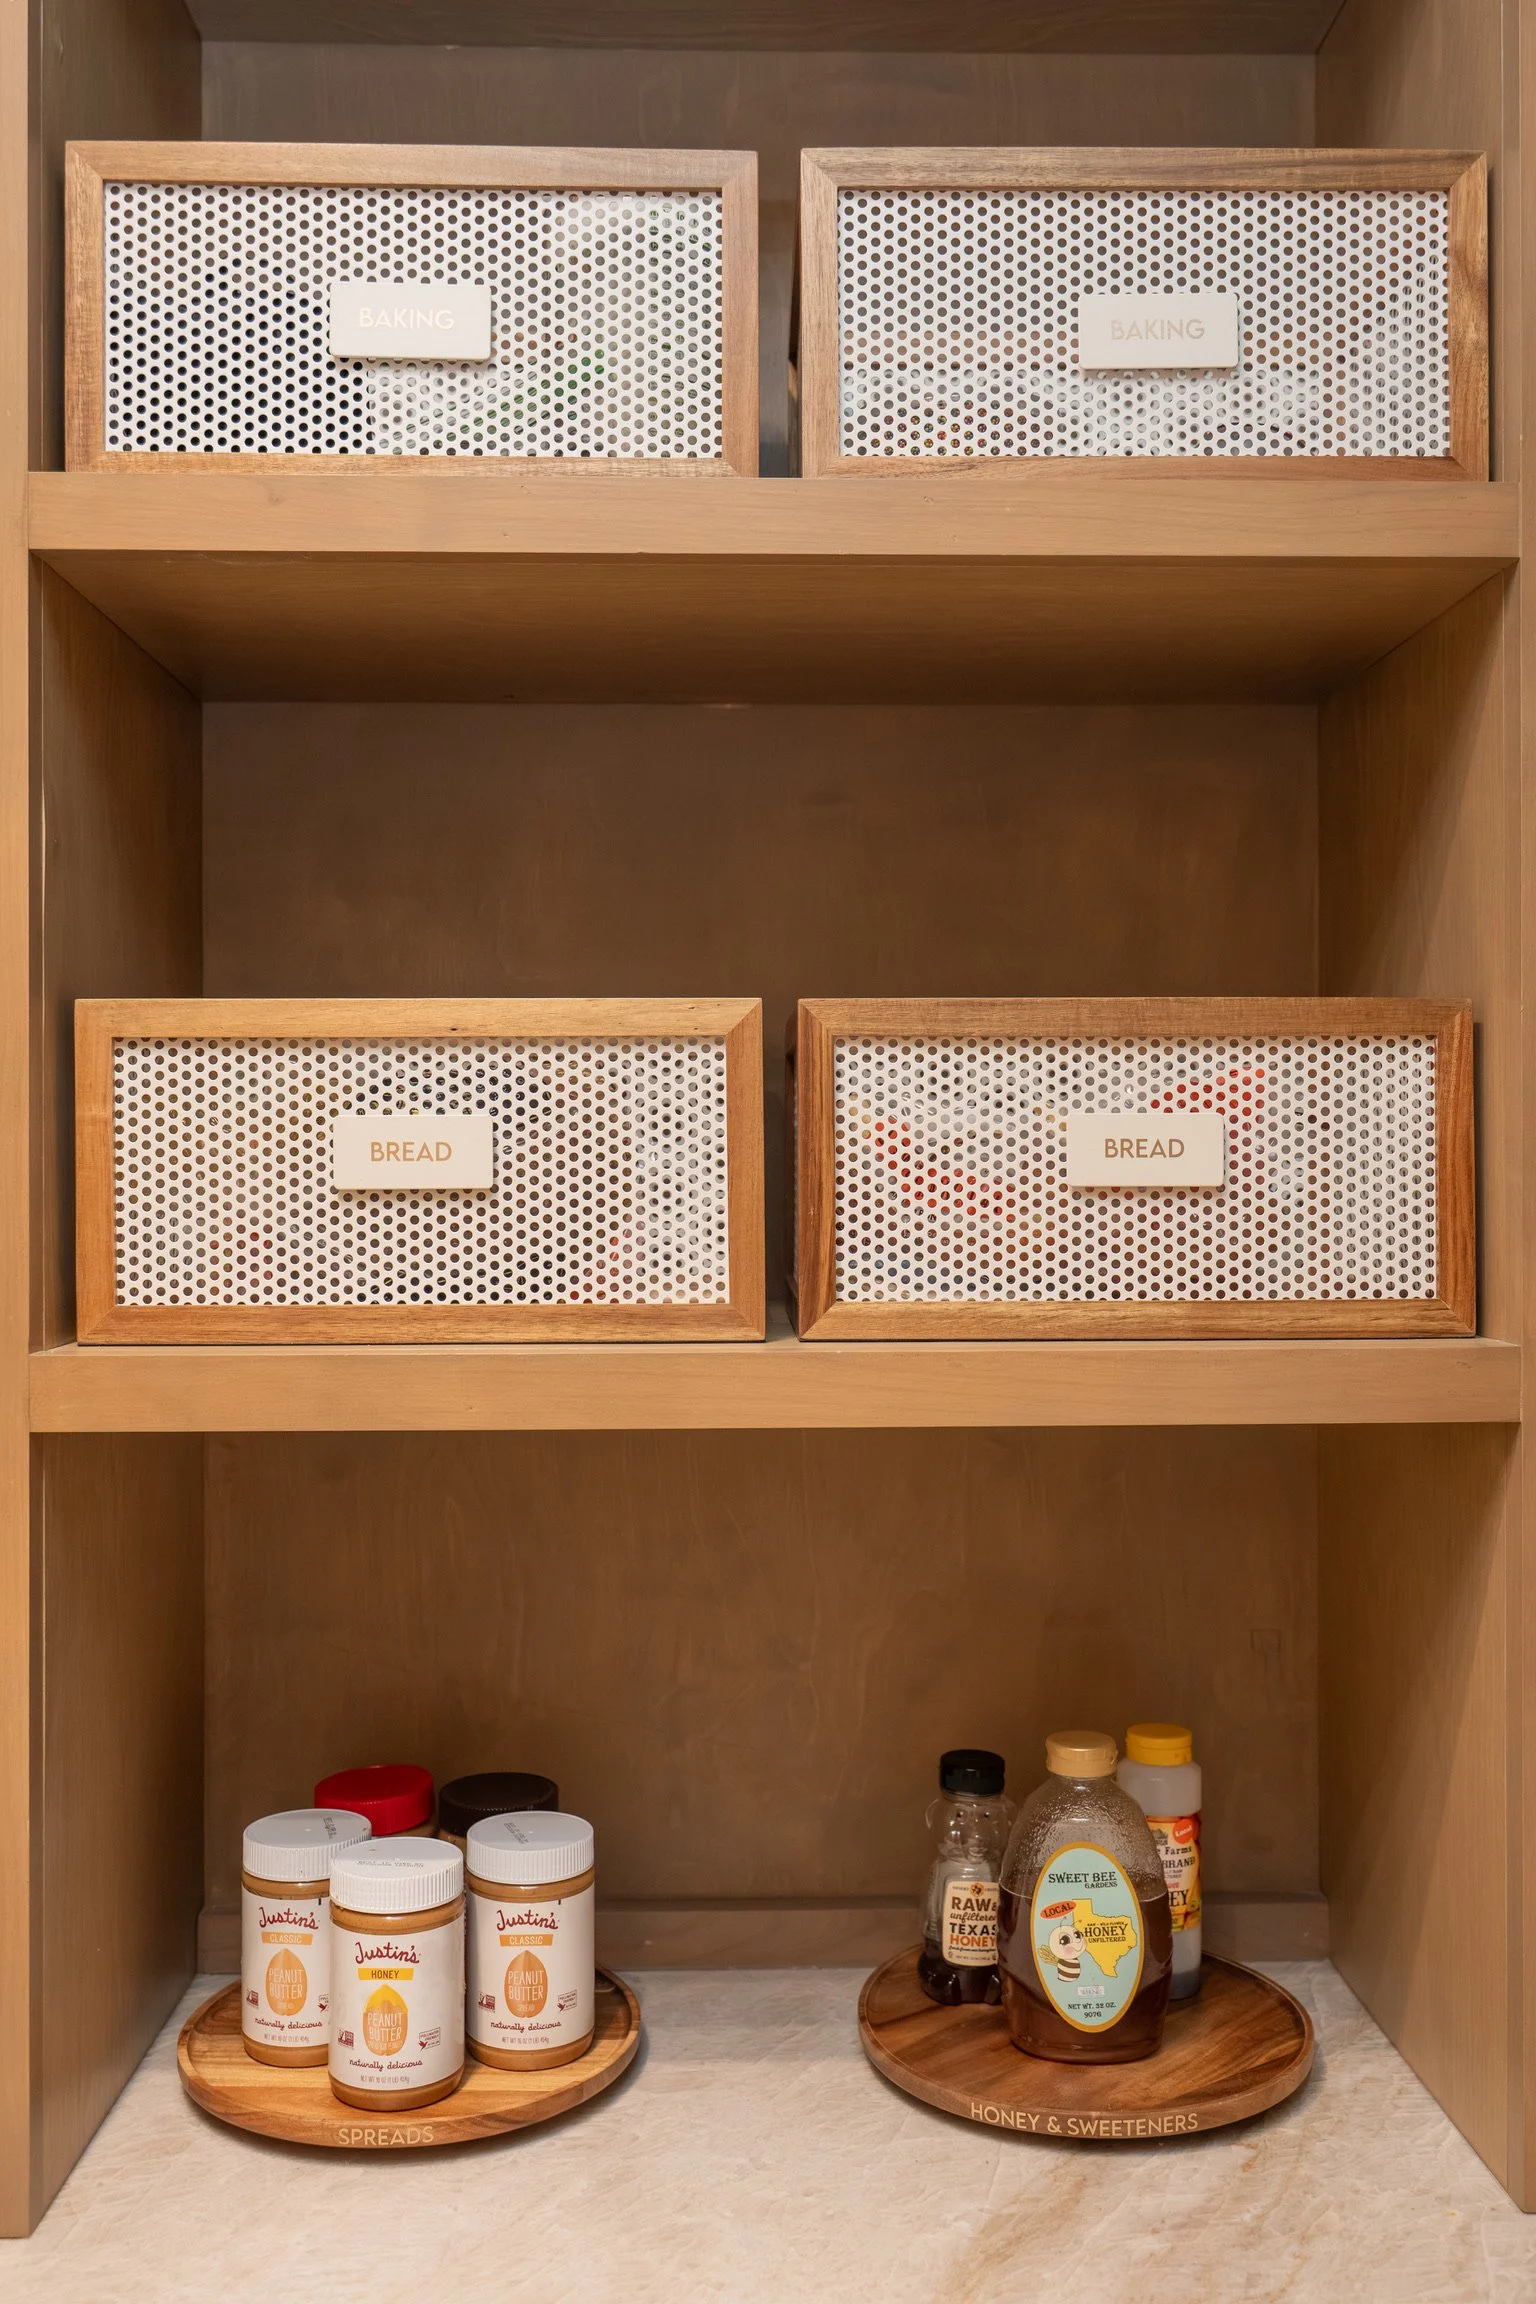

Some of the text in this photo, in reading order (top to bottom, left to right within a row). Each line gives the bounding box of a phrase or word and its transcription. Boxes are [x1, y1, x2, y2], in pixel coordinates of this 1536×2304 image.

[359, 307, 456, 330] BAKING
[1110, 318, 1205, 340] BAKING
[370, 1141, 453, 1162] BREAD
[1104, 1138, 1185, 1159] BREAD
[1048, 1871, 1117, 1883] SWEET BEE
[1084, 1881, 1118, 1889] GARDENS
[1044, 1902, 1074, 1918] LOCAL
[259, 1906, 319, 1930] Justin's
[496, 1909, 558, 1931] Justin's
[949, 1922, 996, 1936] TEXAS
[1084, 1923, 1128, 1937] HONEY
[269, 1933, 302, 1944] CLASSIC
[509, 1935, 543, 1945] CLASSIC
[1088, 1936, 1126, 1944] UNFILTERED
[355, 1941, 420, 1965] Justin's
[268, 1968, 304, 1983] PEANUT
[371, 1969, 400, 1979] HONEY
[508, 1970, 545, 1985] PEANUT
[269, 1983, 303, 2000] BUTTER
[508, 1986, 544, 2001] BUTTER
[254, 2018, 323, 2031] naturally delicious
[367, 2012, 402, 2027] PEANUT
[490, 2021, 562, 2033] naturally delicious
[368, 2027, 402, 2041] BUTTER
[349, 2059, 423, 2072] naturally delicious
[970, 2102, 1199, 2137] HONEY & SWEETENERS
[338, 2125, 435, 2146] SPREADS
